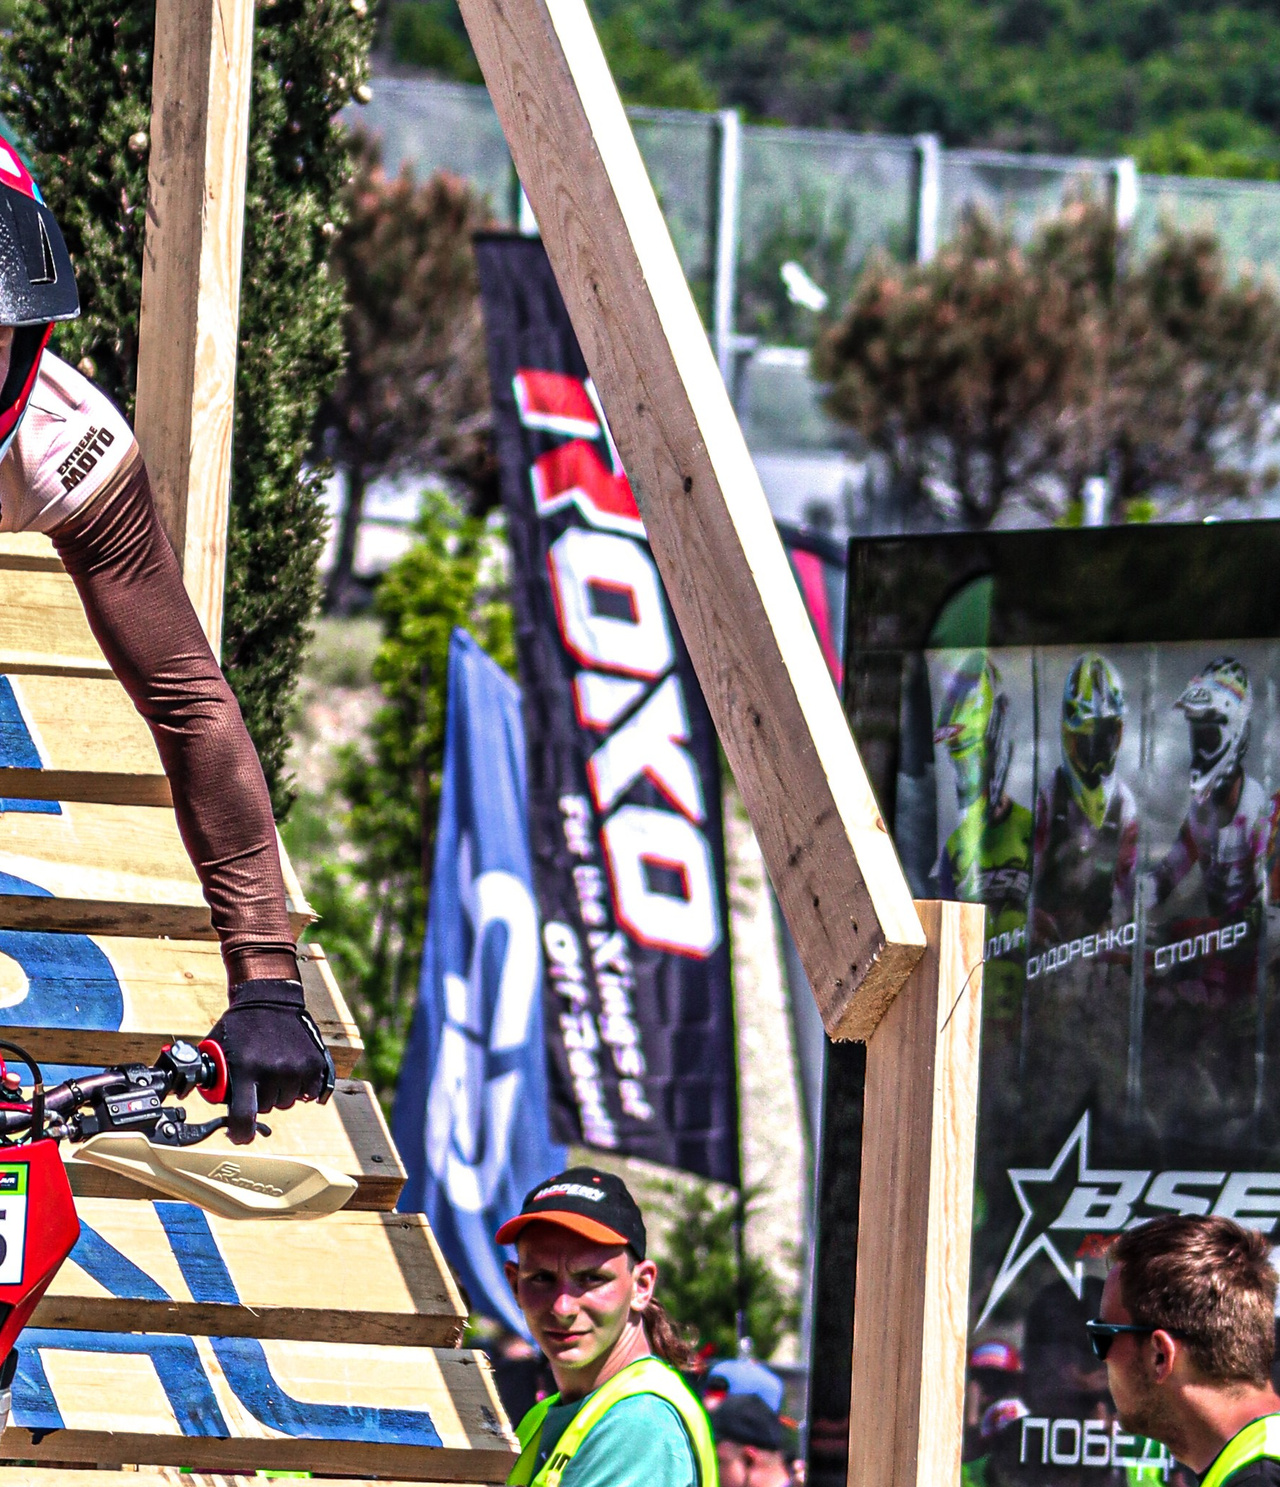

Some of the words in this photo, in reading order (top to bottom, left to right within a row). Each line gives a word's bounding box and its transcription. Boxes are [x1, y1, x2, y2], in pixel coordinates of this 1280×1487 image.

[56, 425, 98, 476] EXTREME
[60, 427, 115, 492] MOTO
[1020, 1417, 1176, 1481] ПОБЕД
